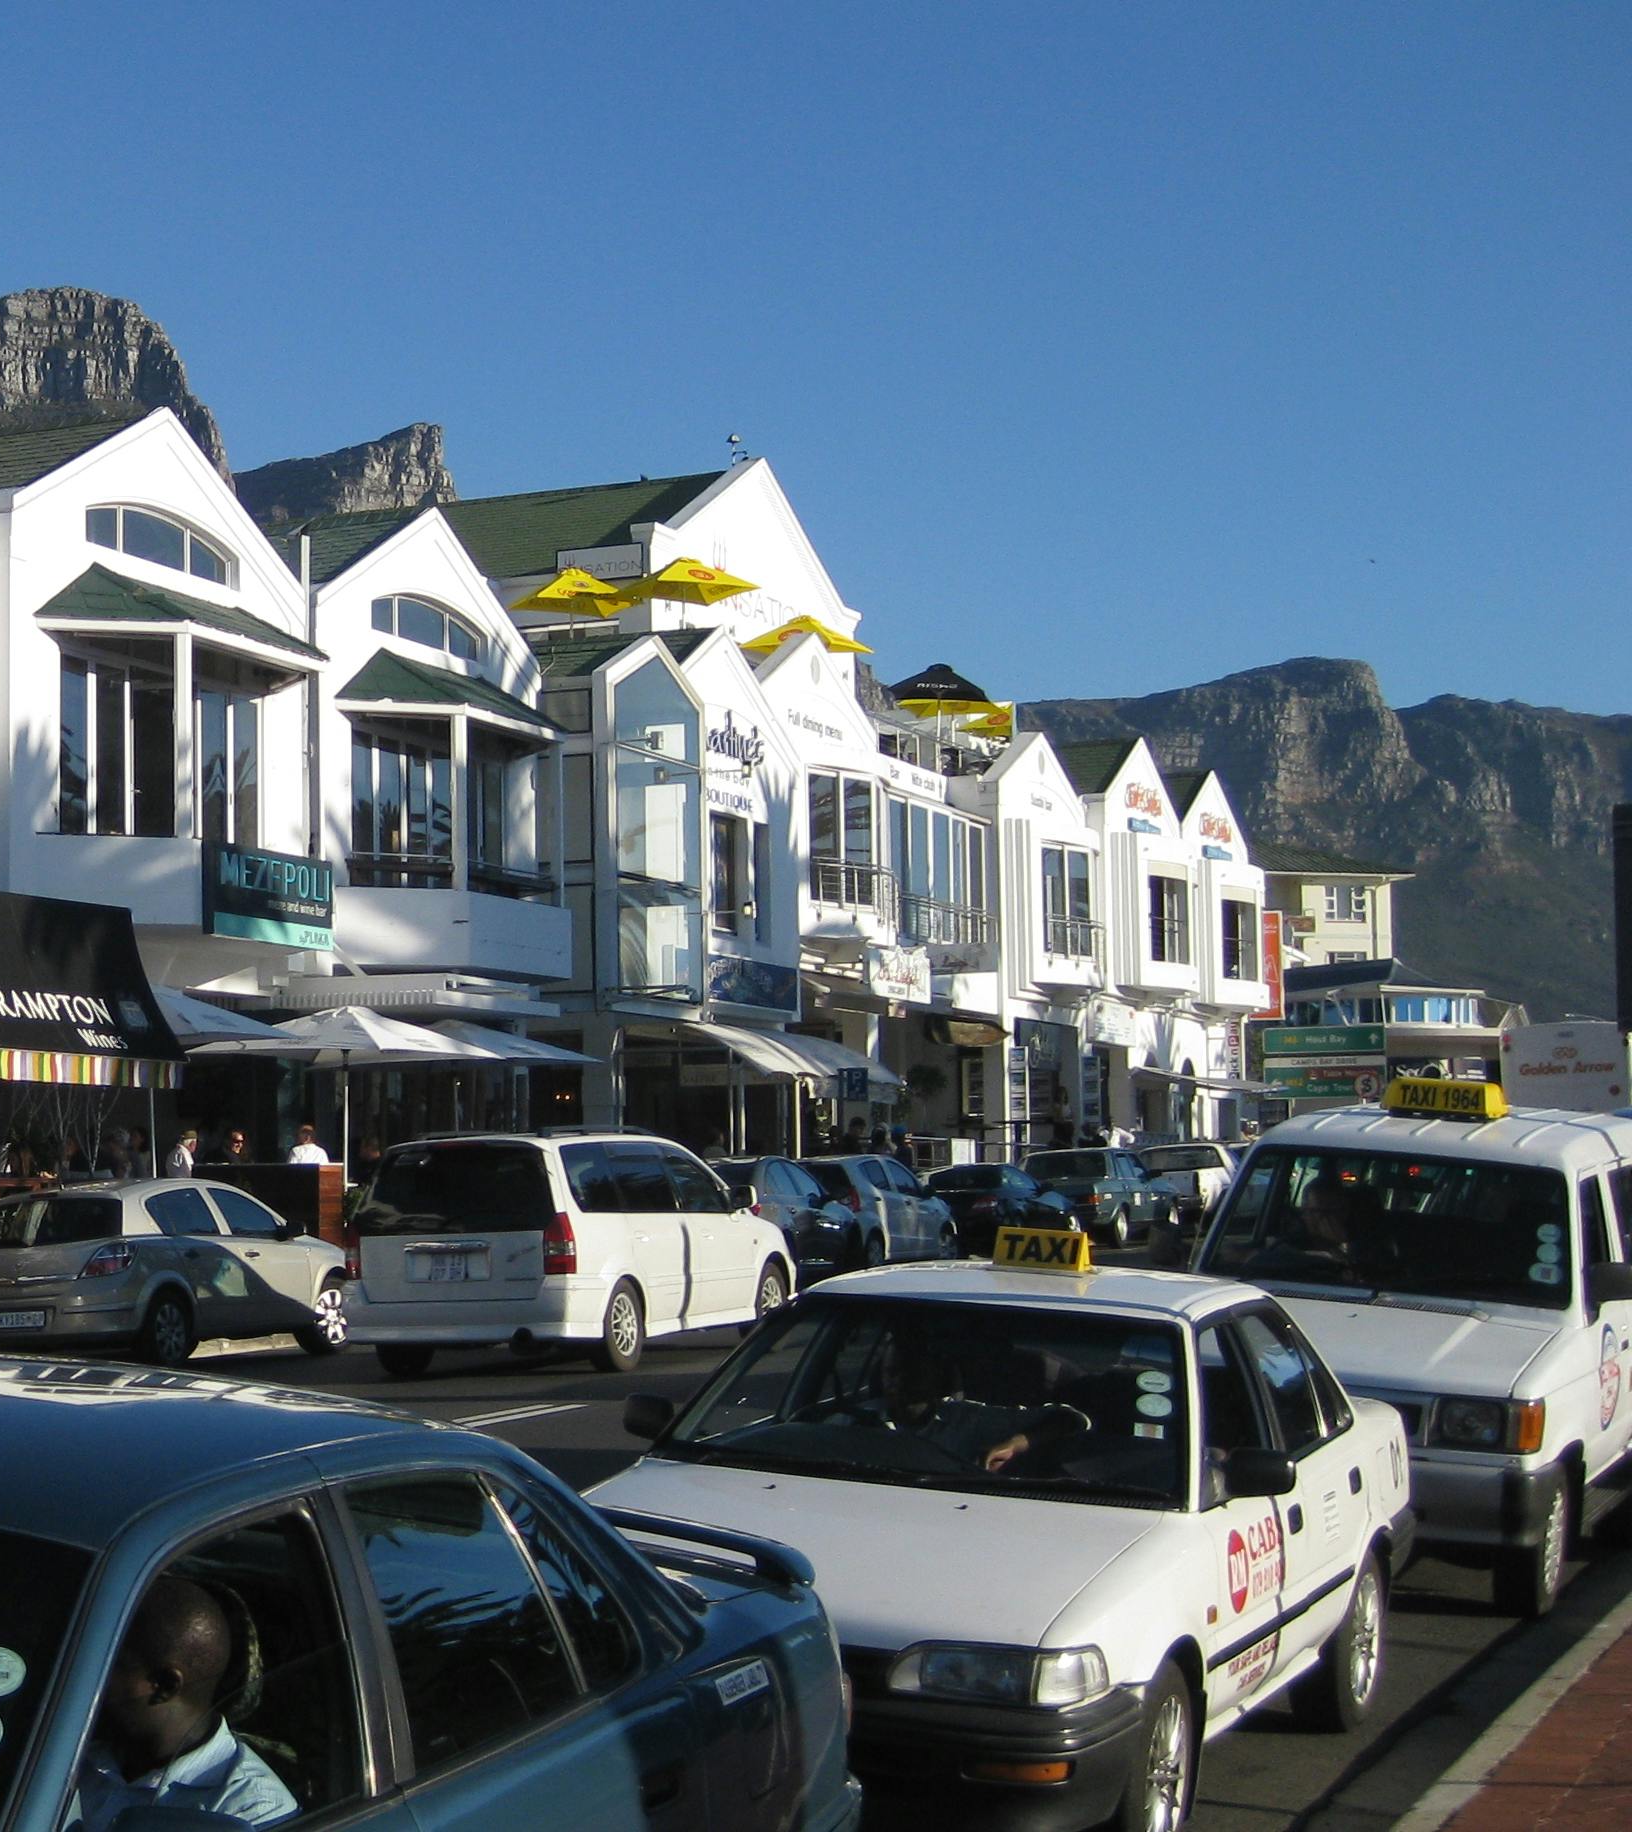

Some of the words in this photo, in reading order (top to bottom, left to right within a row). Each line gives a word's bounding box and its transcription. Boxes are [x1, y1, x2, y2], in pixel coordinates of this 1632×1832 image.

[220, 851, 330, 902] MEZEPOLI
[77, 1027, 129, 1050] Wines
[1329, 1034, 1347, 1045] Bay
[1291, 1058, 1317, 1066] CAMPS
[1519, 1062, 1567, 1076] Golden
[1573, 1061, 1616, 1074] Arrow
[1400, 1084, 1437, 1108] TAXI
[1443, 1088, 1481, 1110] 1964
[1004, 1233, 1080, 1265] TAXI
[1247, 1516, 1283, 1561] CAB
